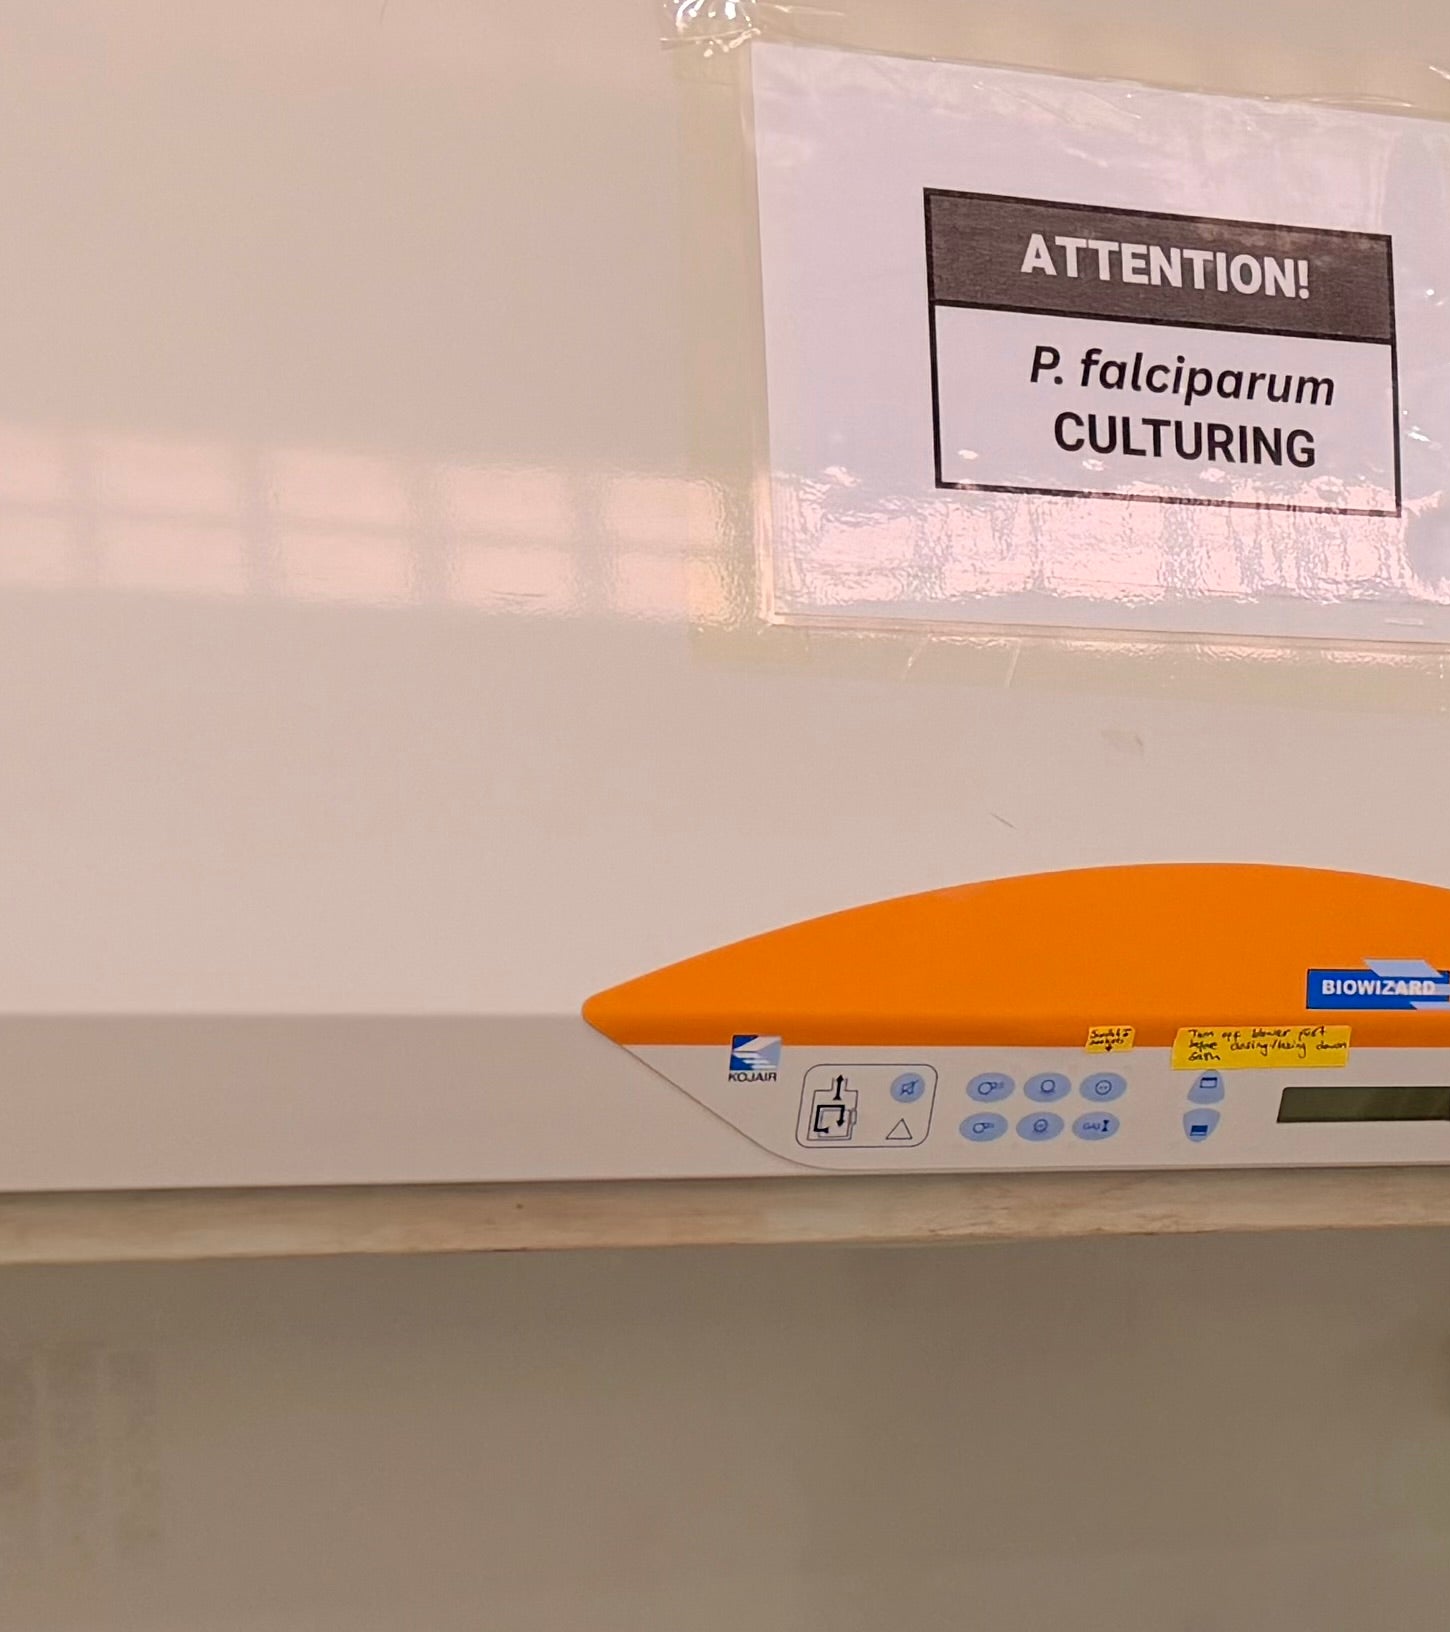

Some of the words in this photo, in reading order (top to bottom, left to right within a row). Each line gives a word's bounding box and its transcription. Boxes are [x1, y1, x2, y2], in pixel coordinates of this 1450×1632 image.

[1021, 234, 1310, 300] ATTENTION!
[1030, 344, 1063, 386] P.
[1079, 346, 1336, 407] falciparum
[1053, 411, 1317, 469] CULTURING
[1321, 979, 1436, 996] BIOWIZARD
